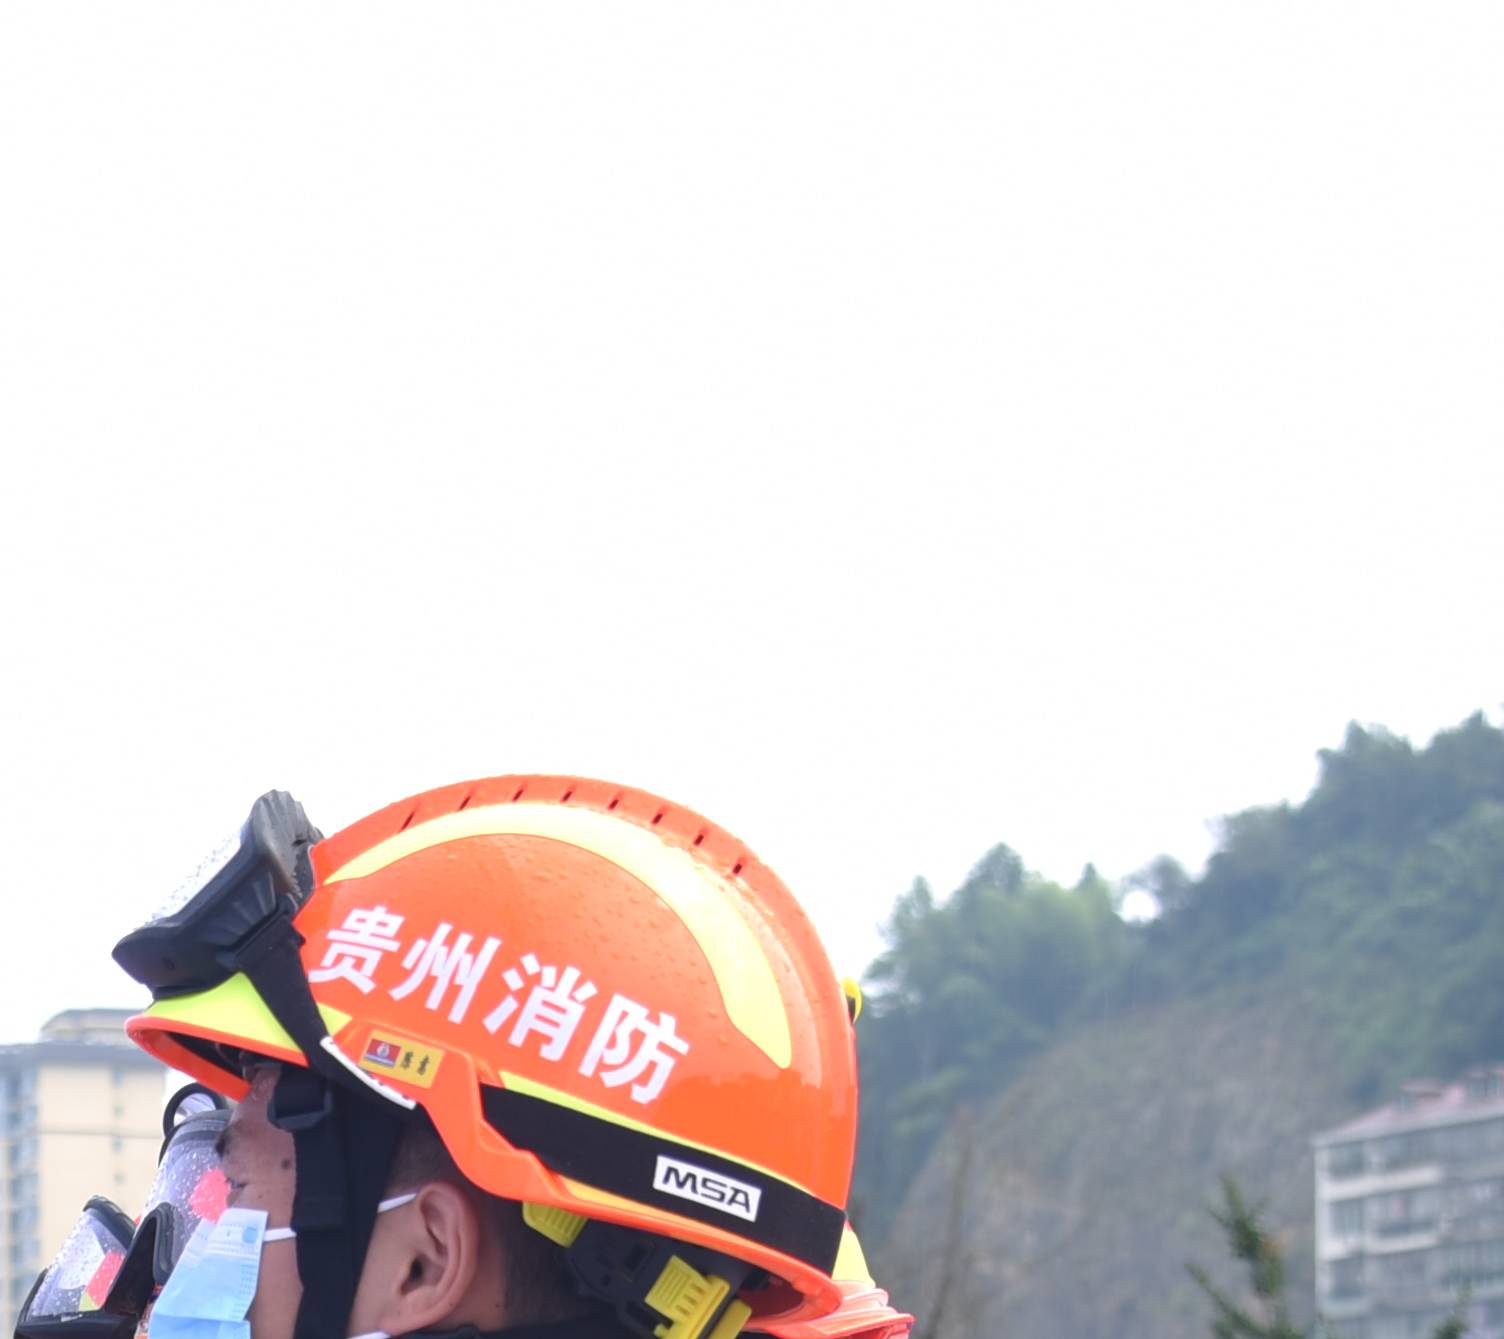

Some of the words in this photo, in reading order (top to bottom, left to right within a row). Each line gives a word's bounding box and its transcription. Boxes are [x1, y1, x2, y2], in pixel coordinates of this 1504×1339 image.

[308, 904, 690, 1106] 贵州消防
[662, 1165, 751, 1214] MSA
